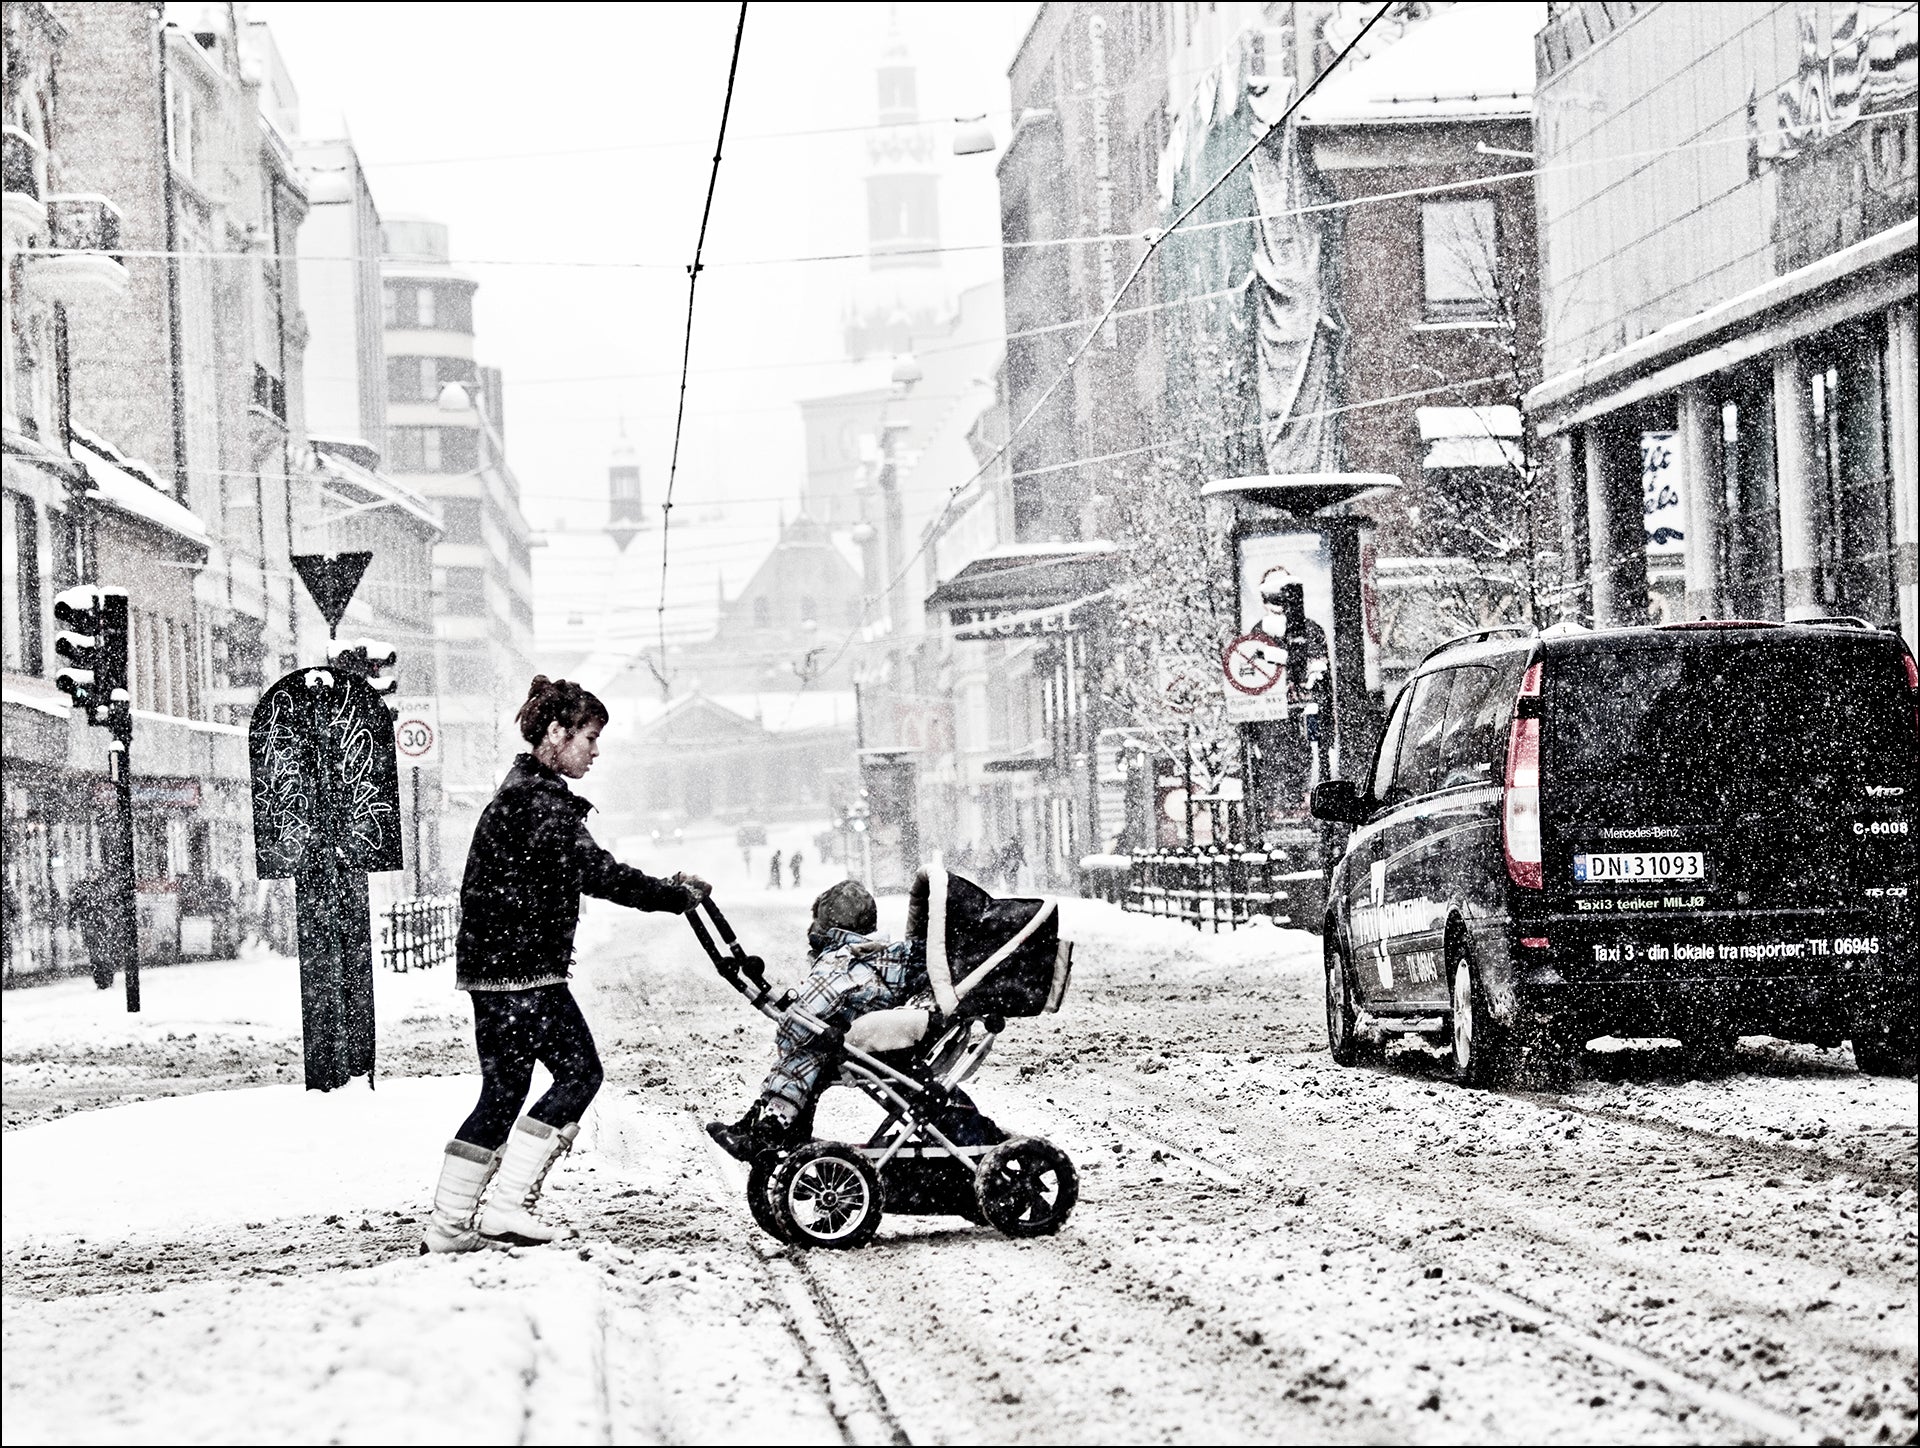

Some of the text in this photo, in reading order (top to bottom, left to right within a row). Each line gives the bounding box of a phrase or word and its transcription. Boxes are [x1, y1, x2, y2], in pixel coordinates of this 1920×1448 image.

[970, 611, 1081, 635] HOTEL
[404, 730, 427, 747] 30
[1603, 827, 1680, 839] Mercedes-Benz
[1853, 822, 1909, 835] C-6008
[1592, 856, 1698, 876] DN 31093
[1576, 896, 1705, 911] Taxi3 tenker MILJØ
[1593, 943, 1620, 961] Taxi
[1624, 944, 1635, 960] 3
[1648, 943, 1670, 960] din
[1674, 942, 1715, 960] lokale
[1834, 937, 1880, 955] 06945
